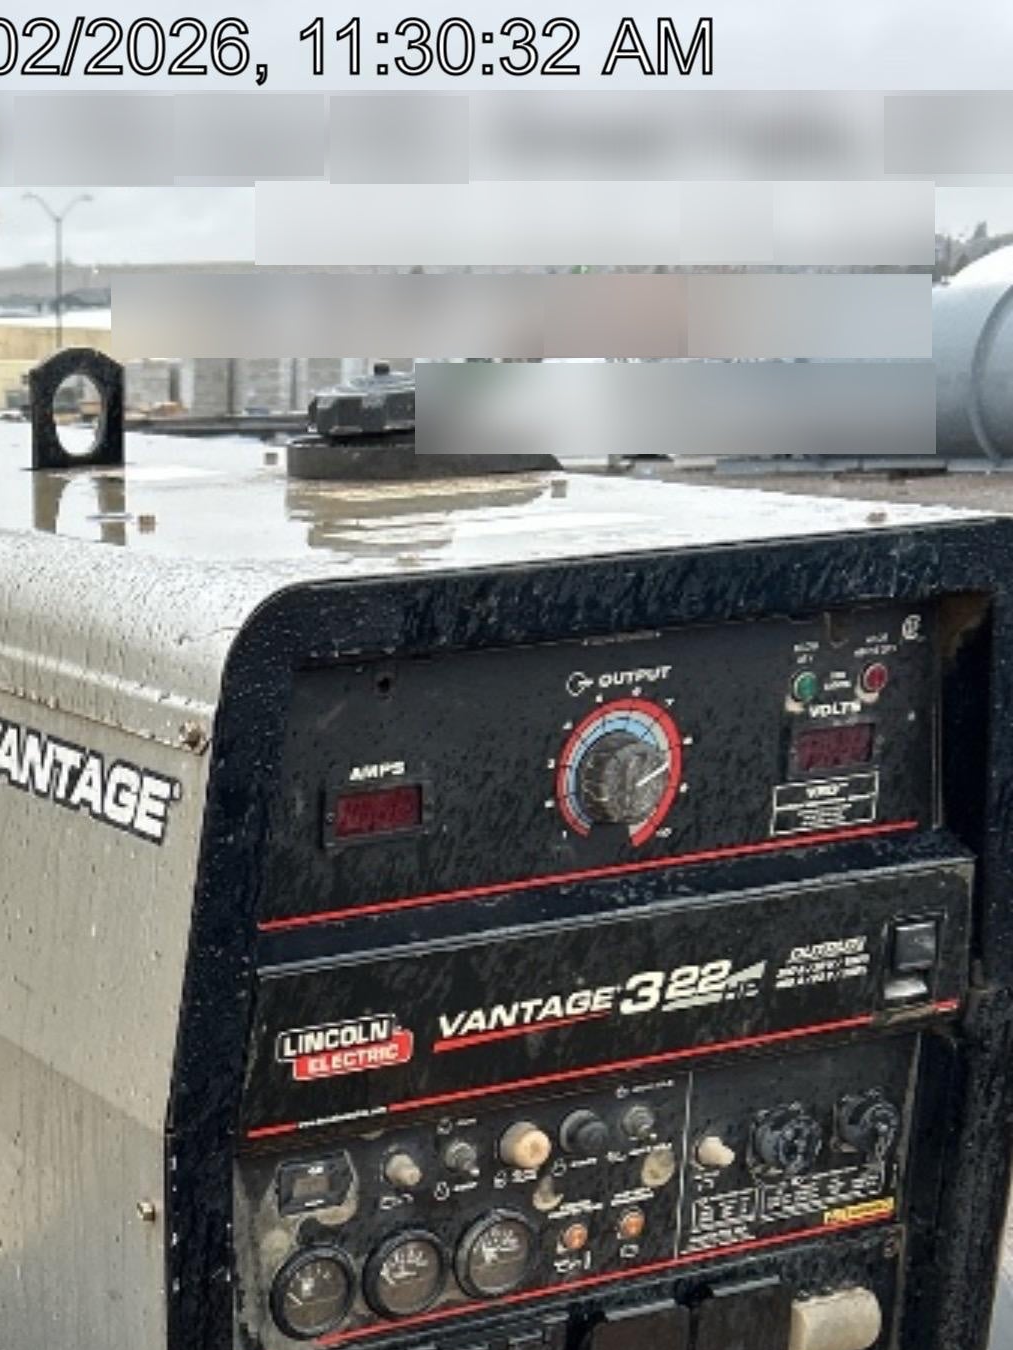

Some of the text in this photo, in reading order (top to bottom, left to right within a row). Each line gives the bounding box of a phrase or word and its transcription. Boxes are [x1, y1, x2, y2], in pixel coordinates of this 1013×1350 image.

[599, 665, 672, 688] OUTPUT
[349, 761, 405, 781] AMPS
[439, 987, 616, 1039] VANTAGE
[620, 959, 733, 1015] 322
[283, 1018, 389, 1057] LINCOLN
[307, 1043, 399, 1075] ELECTRIC
